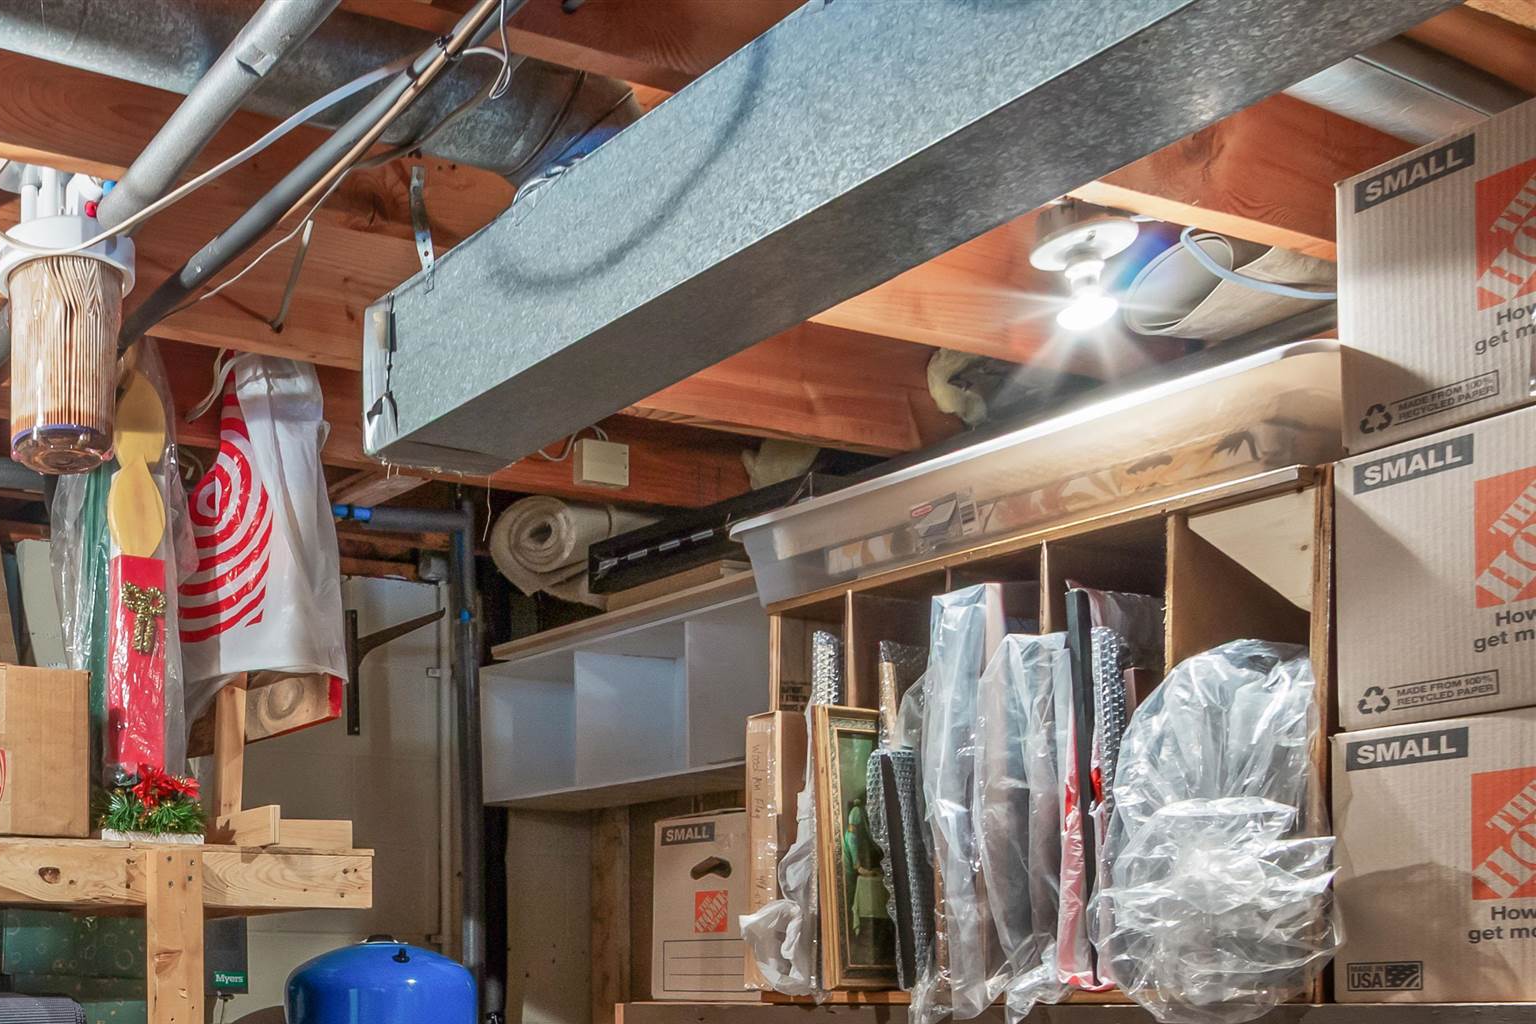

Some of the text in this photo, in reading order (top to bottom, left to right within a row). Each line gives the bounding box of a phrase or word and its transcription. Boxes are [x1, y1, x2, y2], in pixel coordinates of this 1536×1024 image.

[1364, 148, 1463, 203] SMALL
[1475, 330, 1509, 355] get
[1430, 385, 1463, 405] FROM
[1457, 385, 1495, 403] PAPER
[1364, 445, 1462, 486] SMALL
[1473, 632, 1509, 653] get
[1396, 675, 1493, 697] MADE FROM 100%
[1396, 684, 1494, 706] RECYCLED PAPER
[1356, 735, 1457, 765] SMALL
[665, 825, 710, 842] SMALL
[1468, 925, 1503, 944] get
[215, 974, 244, 985] Myers
[1350, 972, 1383, 988] USA
